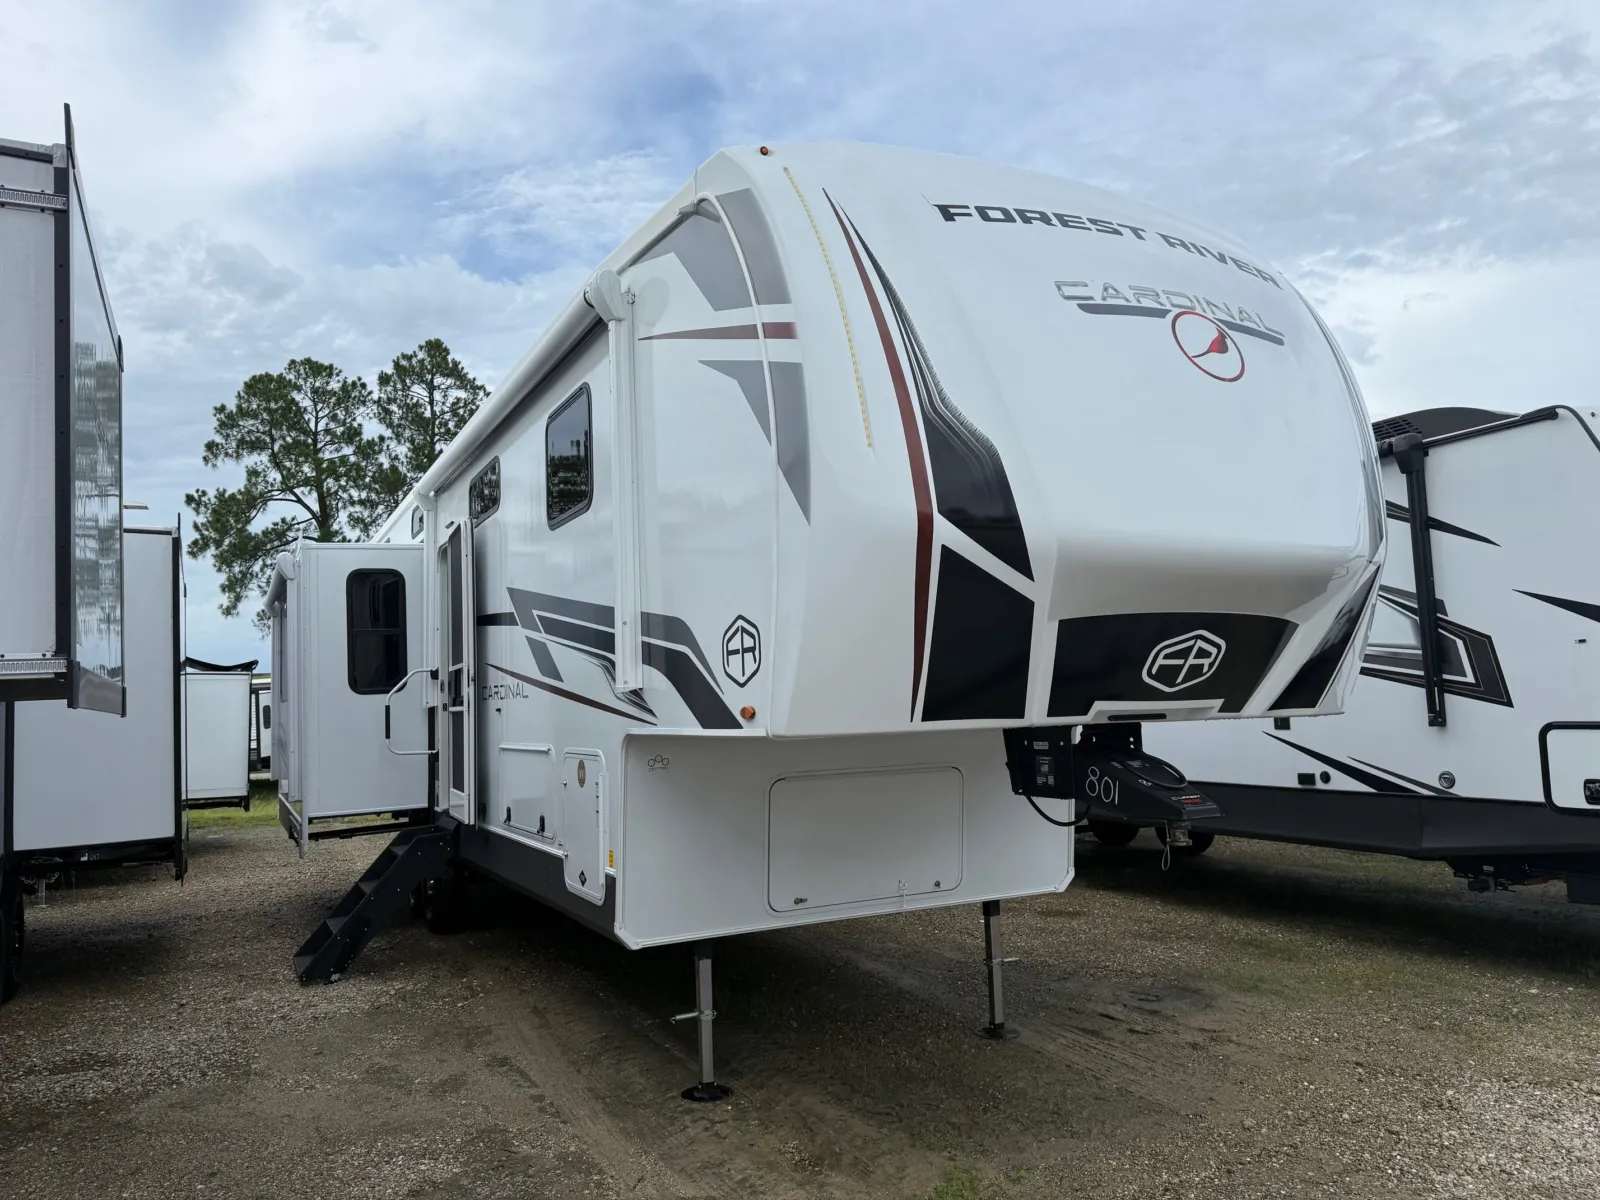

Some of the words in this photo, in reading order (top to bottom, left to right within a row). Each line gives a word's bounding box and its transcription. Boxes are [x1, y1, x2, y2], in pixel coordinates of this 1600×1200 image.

[933, 203, 1146, 241] FOREST
[1154, 231, 1284, 290] RIVER
[1054, 280, 1286, 338] CARDINAL
[481, 682, 529, 701] CARDINAL
[1085, 766, 1119, 804] 801
